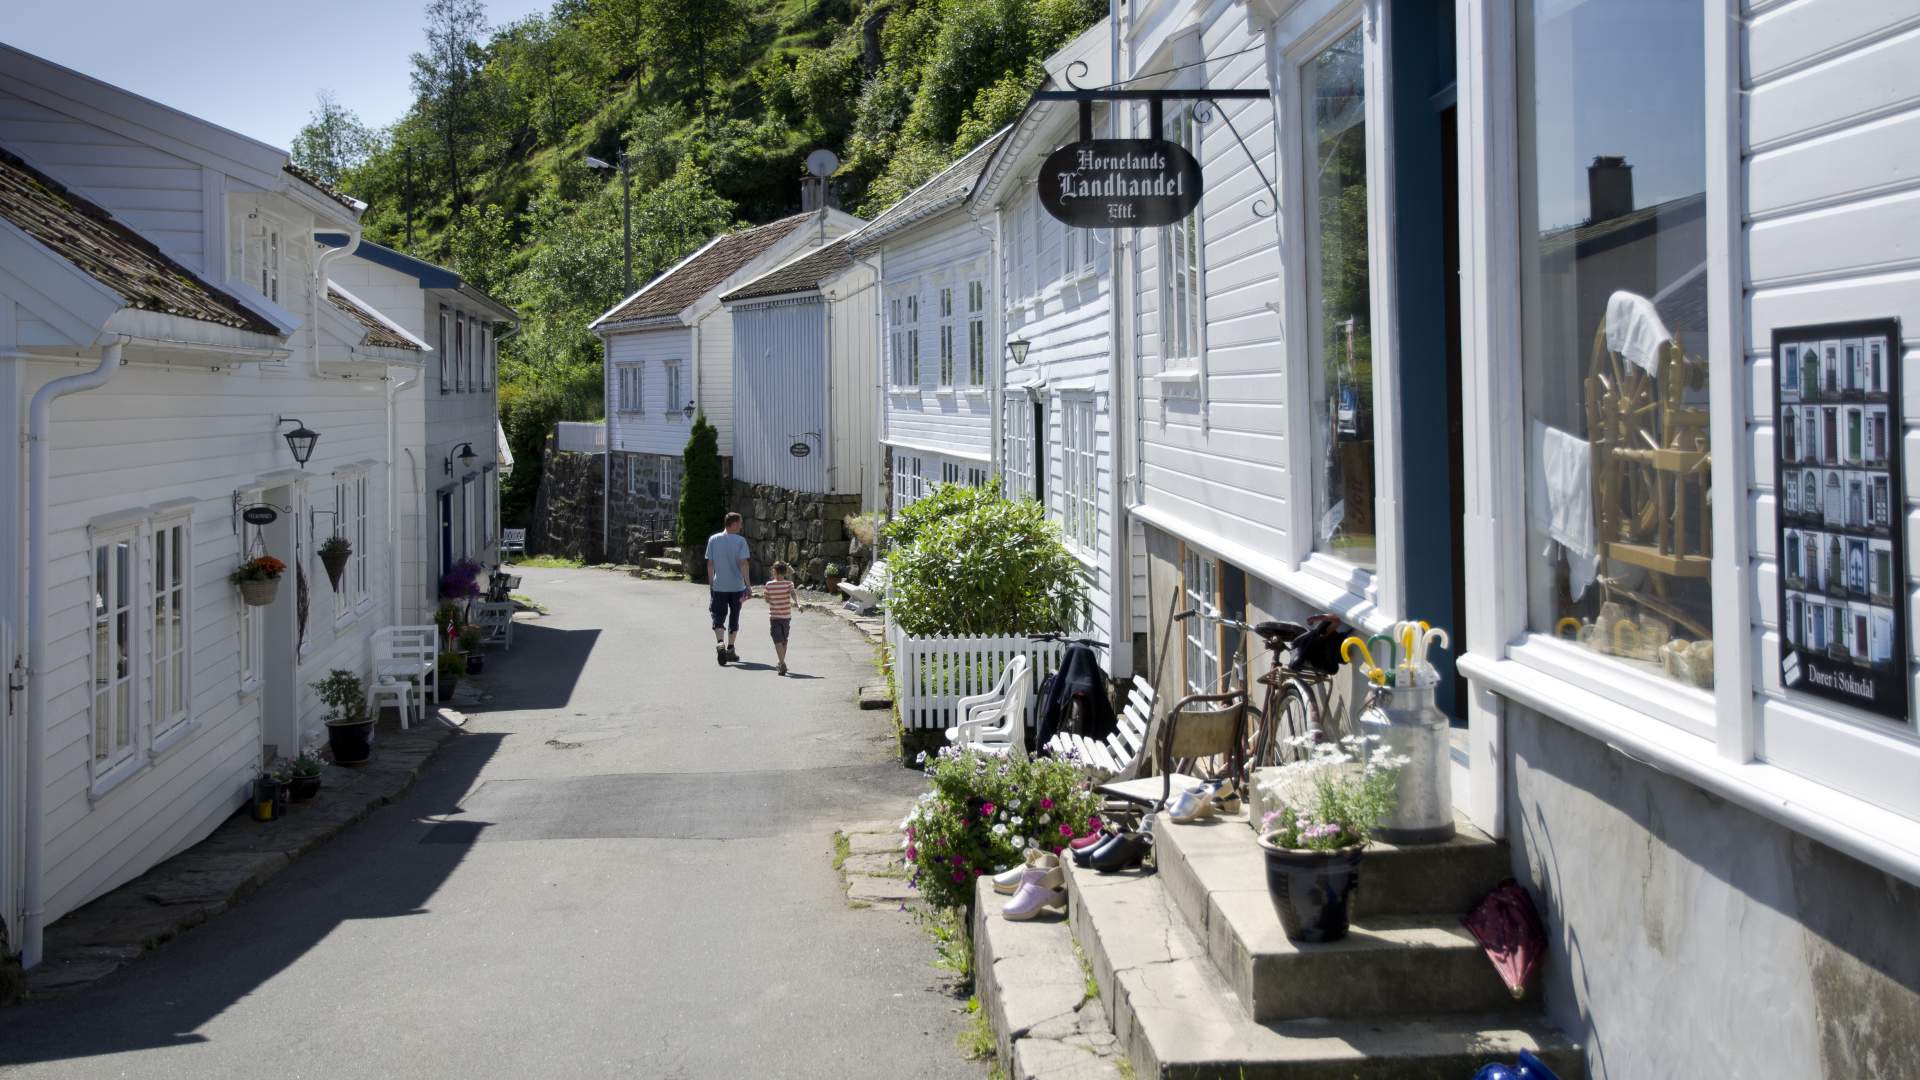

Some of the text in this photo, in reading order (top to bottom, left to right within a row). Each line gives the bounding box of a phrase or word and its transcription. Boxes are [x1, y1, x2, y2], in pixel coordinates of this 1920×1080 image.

[1076, 149, 1166, 173] Hornelands
[1058, 171, 1184, 205] Landhandel
[1838, 672, 1873, 698] Sokndal
